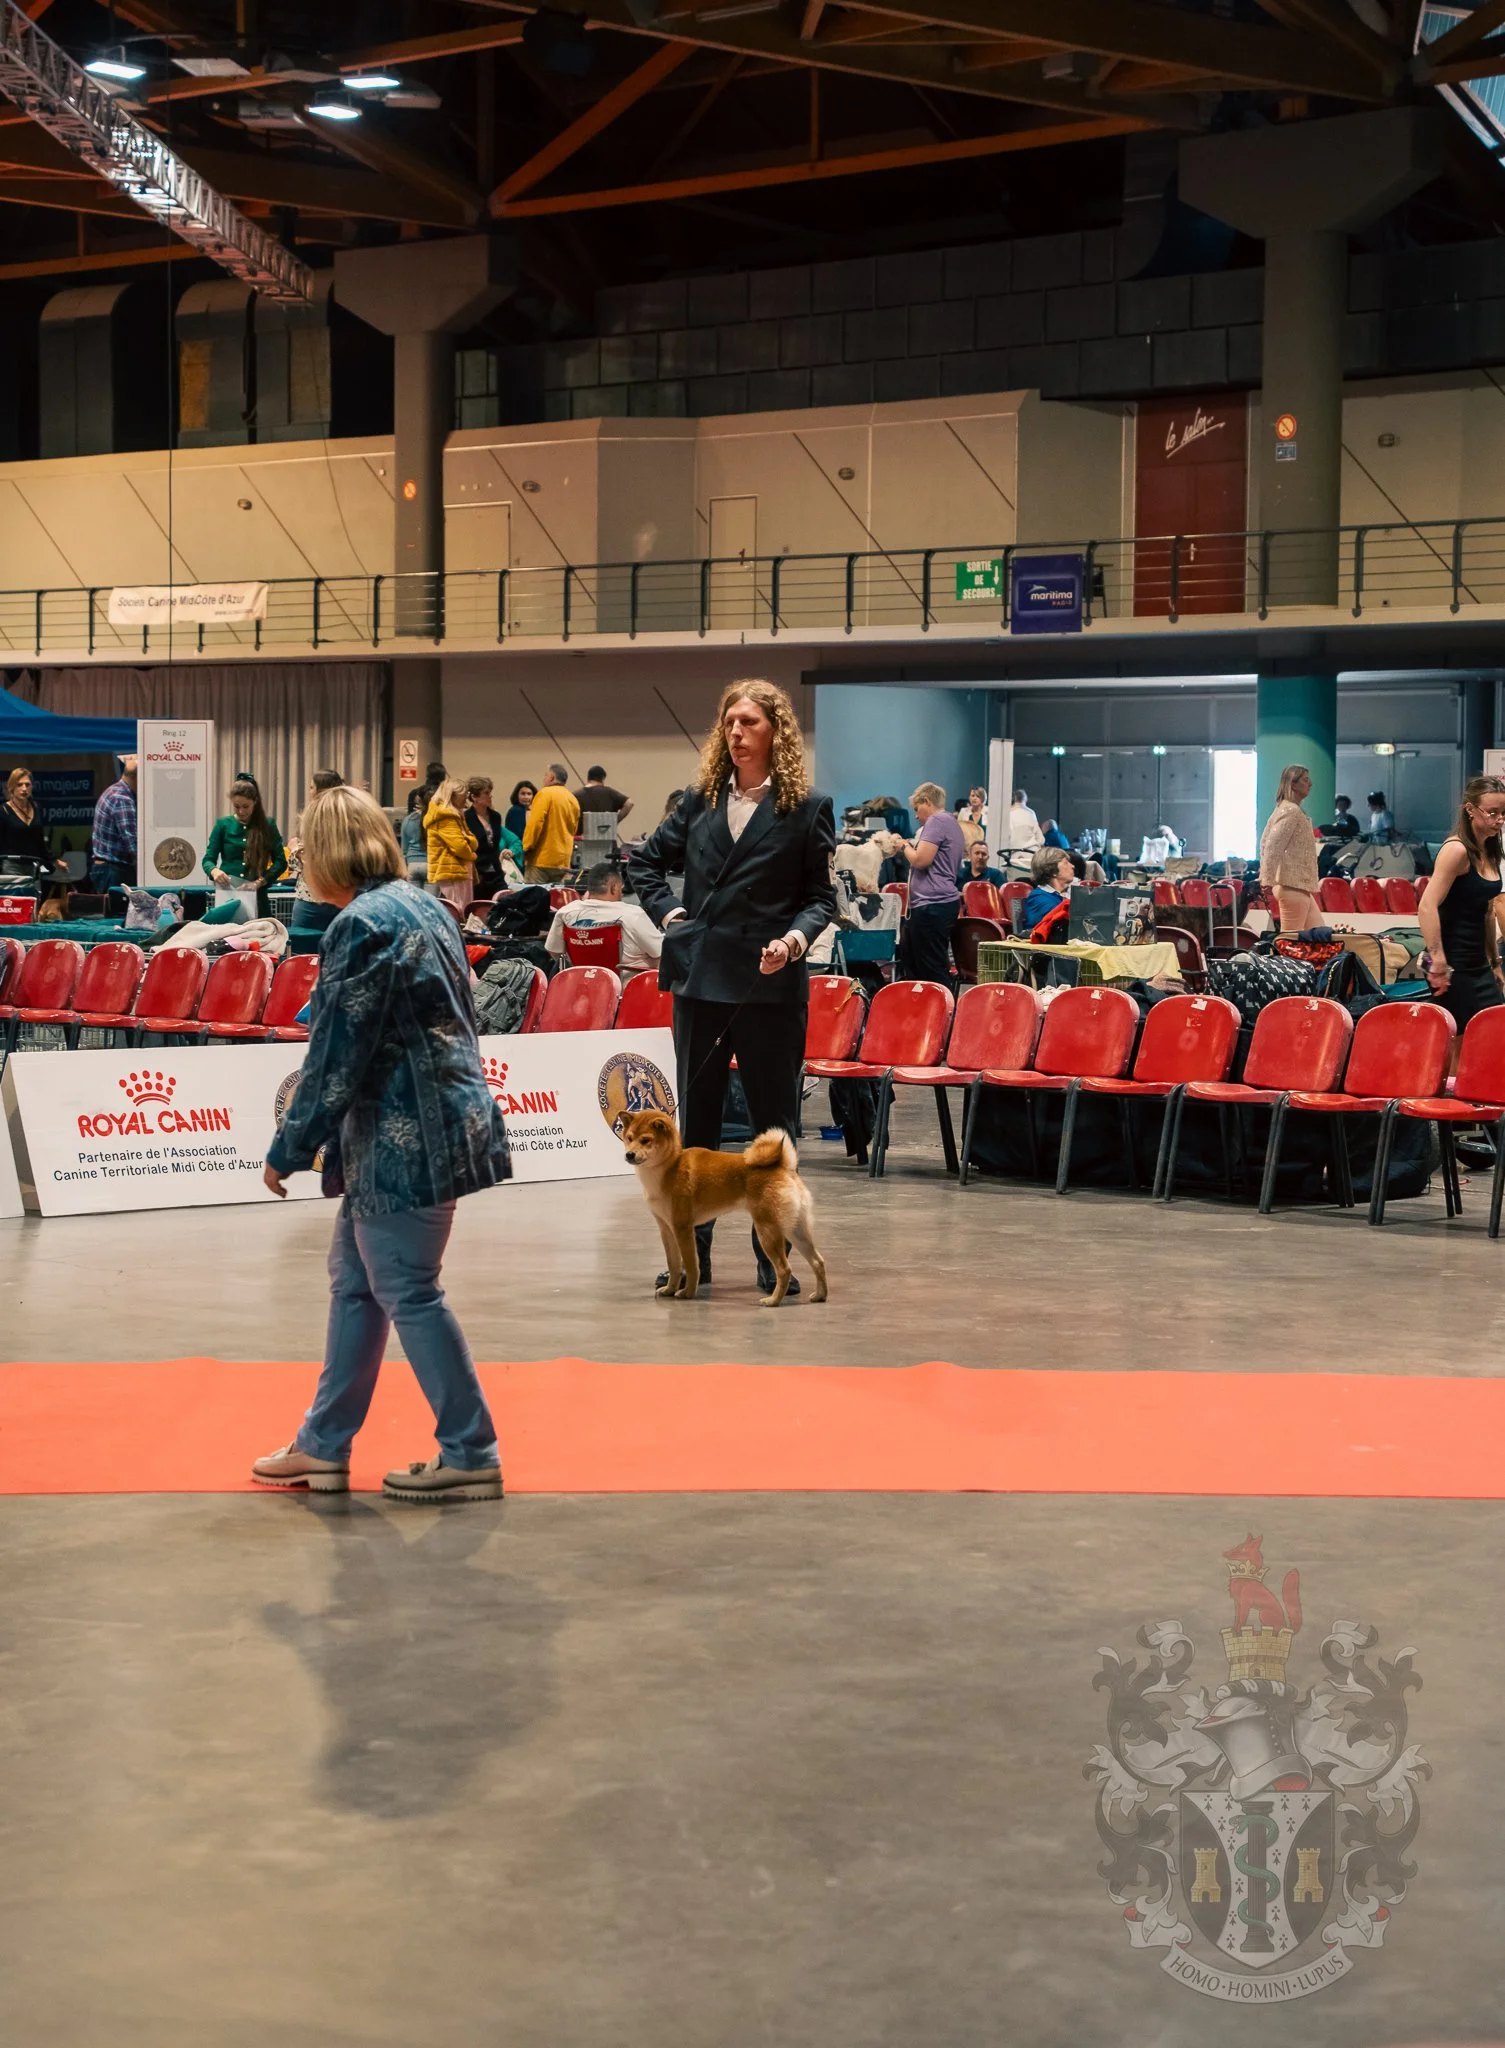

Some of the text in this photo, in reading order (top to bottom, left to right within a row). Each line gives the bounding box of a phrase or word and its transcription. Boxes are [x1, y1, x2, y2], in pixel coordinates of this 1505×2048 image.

[966, 561, 992, 573] SORTIE
[974, 575, 985, 586] DE
[962, 587, 996, 600] SECOURS
[1030, 590, 1073, 601] maritima
[162, 729, 177, 738] Ring
[146, 753, 202, 762] ROYAL CANIN
[495, 1091, 558, 1115] CANIN
[77, 1107, 231, 1138] ROYAL CANIN
[530, 1140, 554, 1151] Côte
[556, 1138, 587, 1149] d'Azur
[78, 1145, 237, 1164] Partenaire de l'Association
[53, 1159, 264, 1181] Canine Territoriale Midi Côte d'Azur
